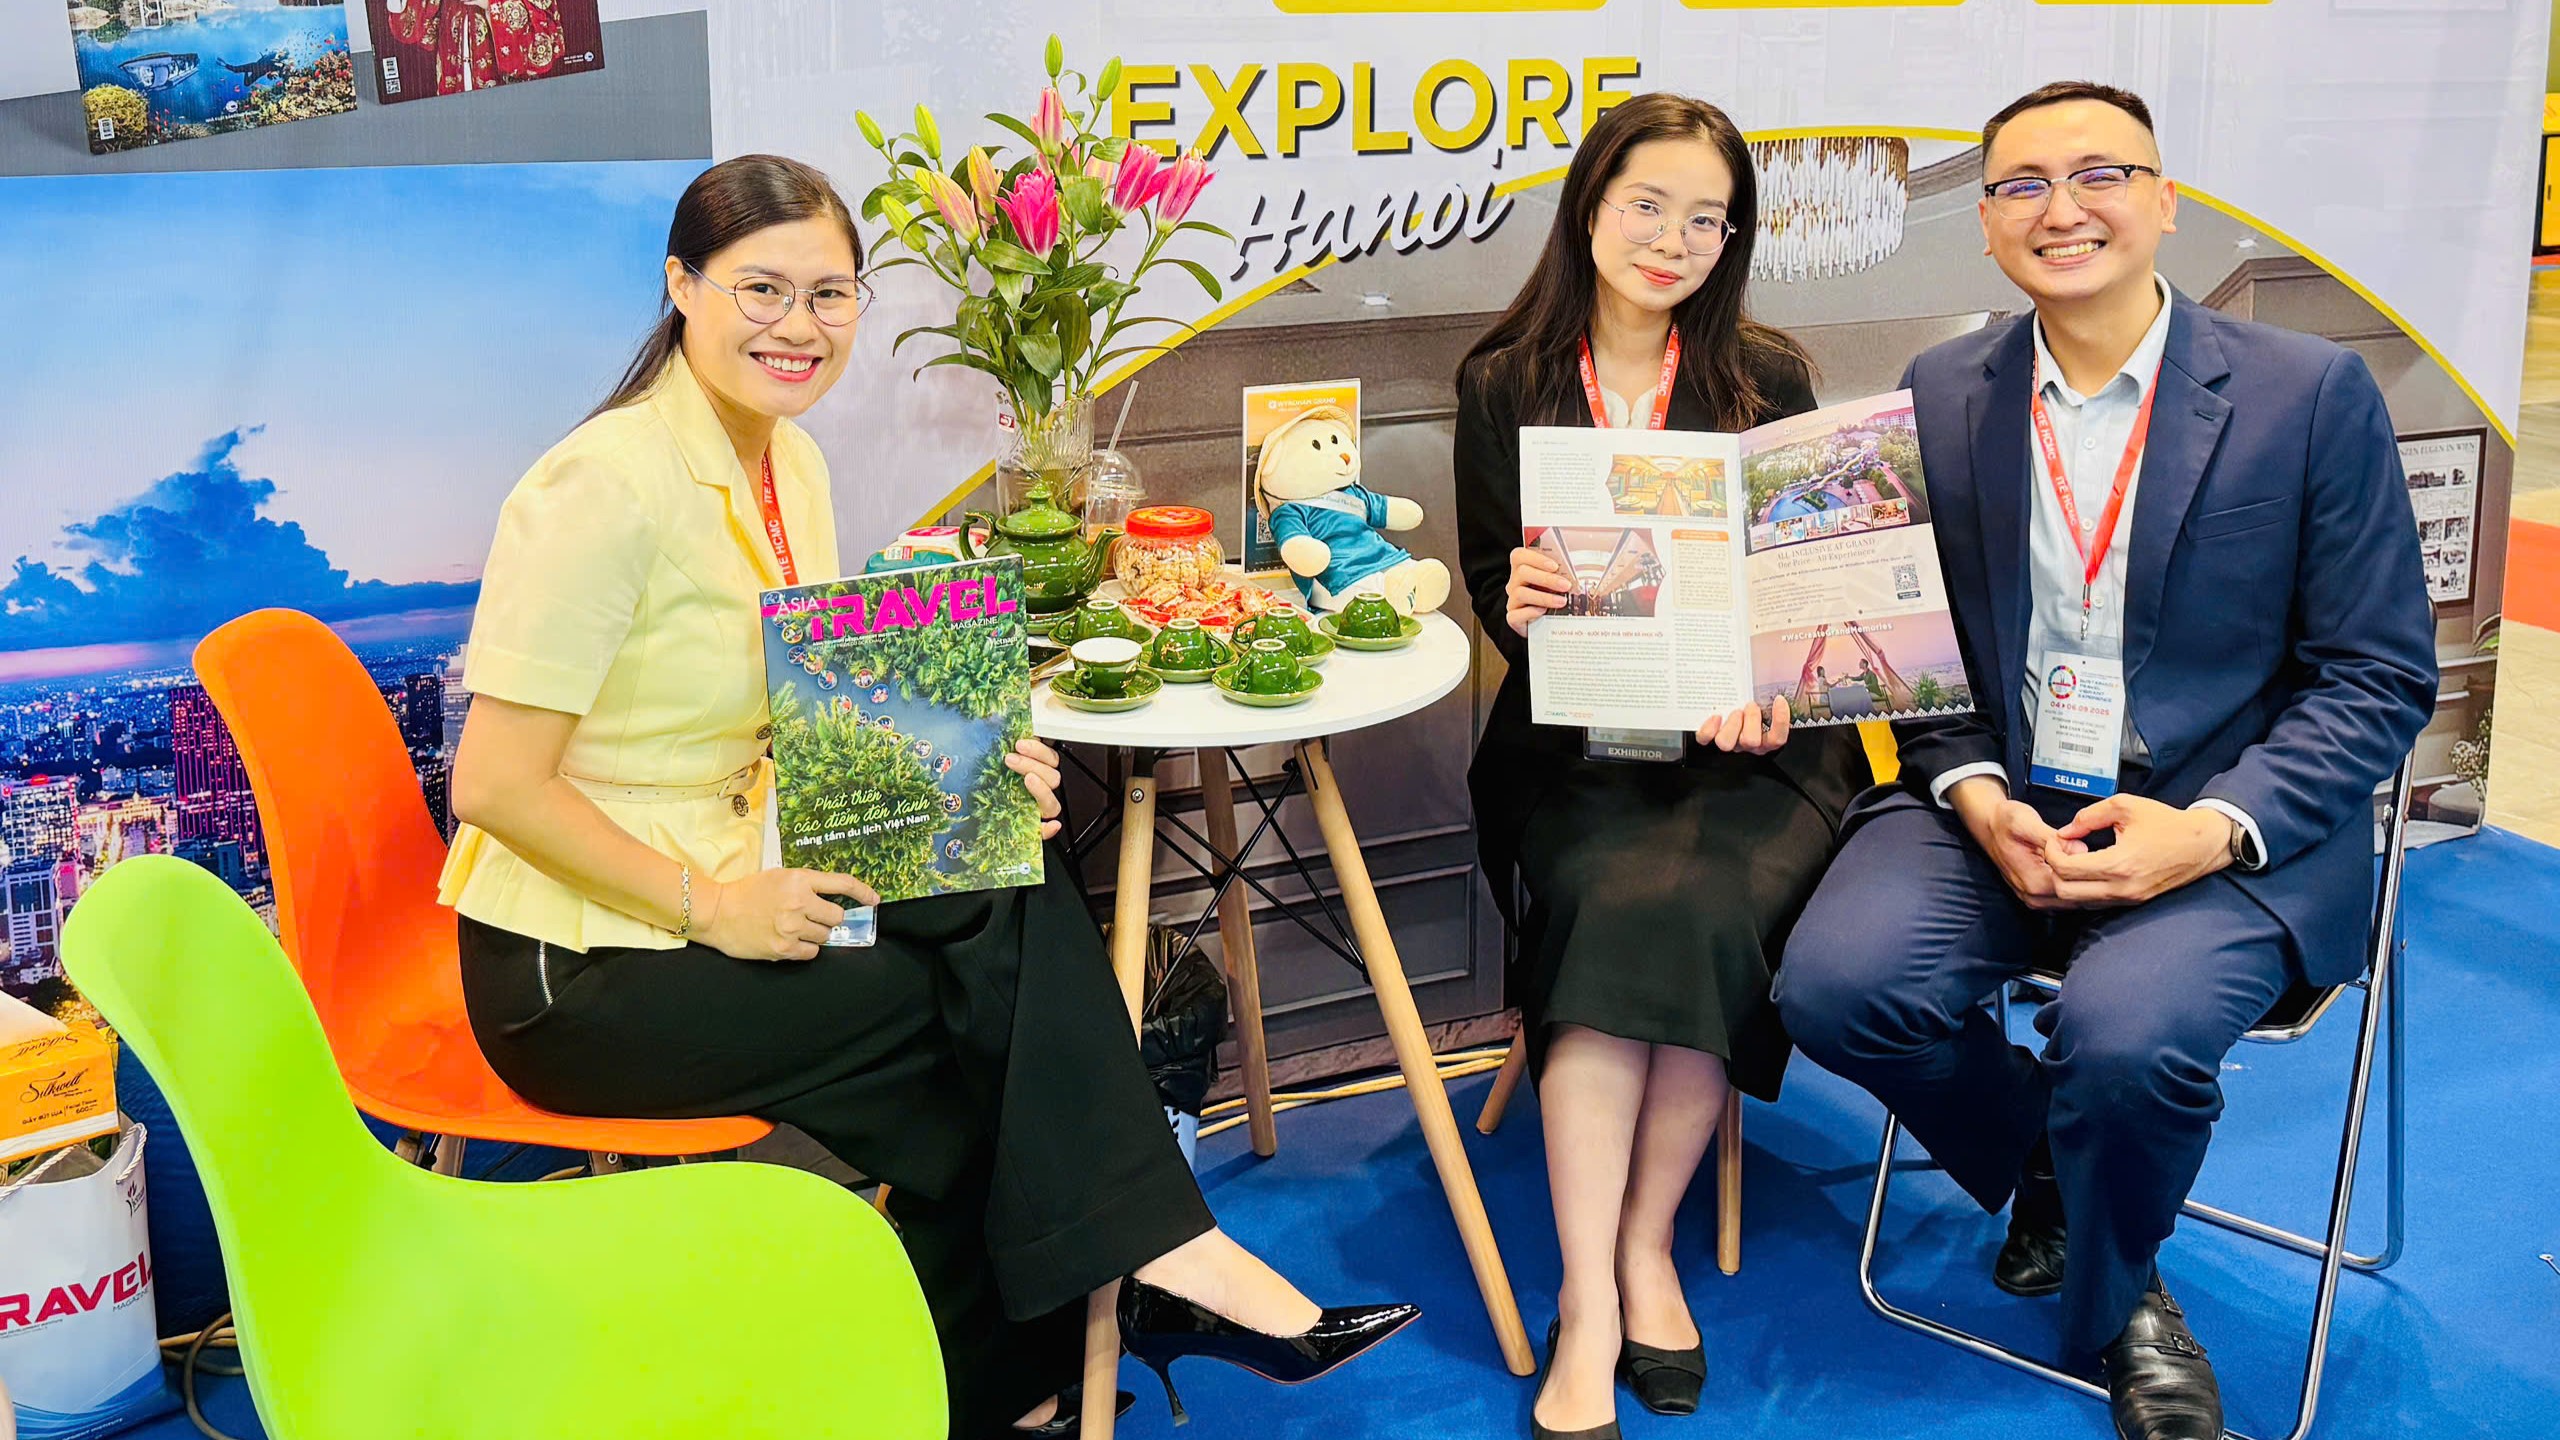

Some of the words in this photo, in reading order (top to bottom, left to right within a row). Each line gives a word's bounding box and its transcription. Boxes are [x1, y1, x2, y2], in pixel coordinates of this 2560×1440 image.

[1110, 55, 1641, 159] EXPLORE
[1231, 148, 1514, 280] Hanoi
[1665, 349, 1676, 365] ITE
[1587, 385, 1598, 401] ITE
[1658, 367, 1672, 397] HCMC
[2035, 410, 2049, 427] ITE
[2040, 427, 2057, 460] HCMC
[764, 486, 773, 504] ITE
[2055, 475, 2068, 494] ITE
[2061, 492, 2078, 526] HCMC
[769, 519, 788, 555] HCMC
[778, 555, 792, 575] ITE
[761, 575, 1018, 641] TRAVEL
[774, 595, 820, 617] ASIA
[950, 616, 998, 630] MAGAZINE
[1608, 747, 1662, 759] EXHIBITOR
[2054, 773, 2089, 789] SELLER
[793, 816, 821, 834] các
[892, 790, 931, 816] Xanh
[814, 793, 848, 812] Phát
[847, 828, 860, 838] du
[863, 823, 881, 836] lịch
[883, 818, 905, 830] Việt
[906, 813, 931, 824] Nam
[20, 1068, 89, 1103] Silkwell
[0, 1250, 153, 1331] RAVEL
